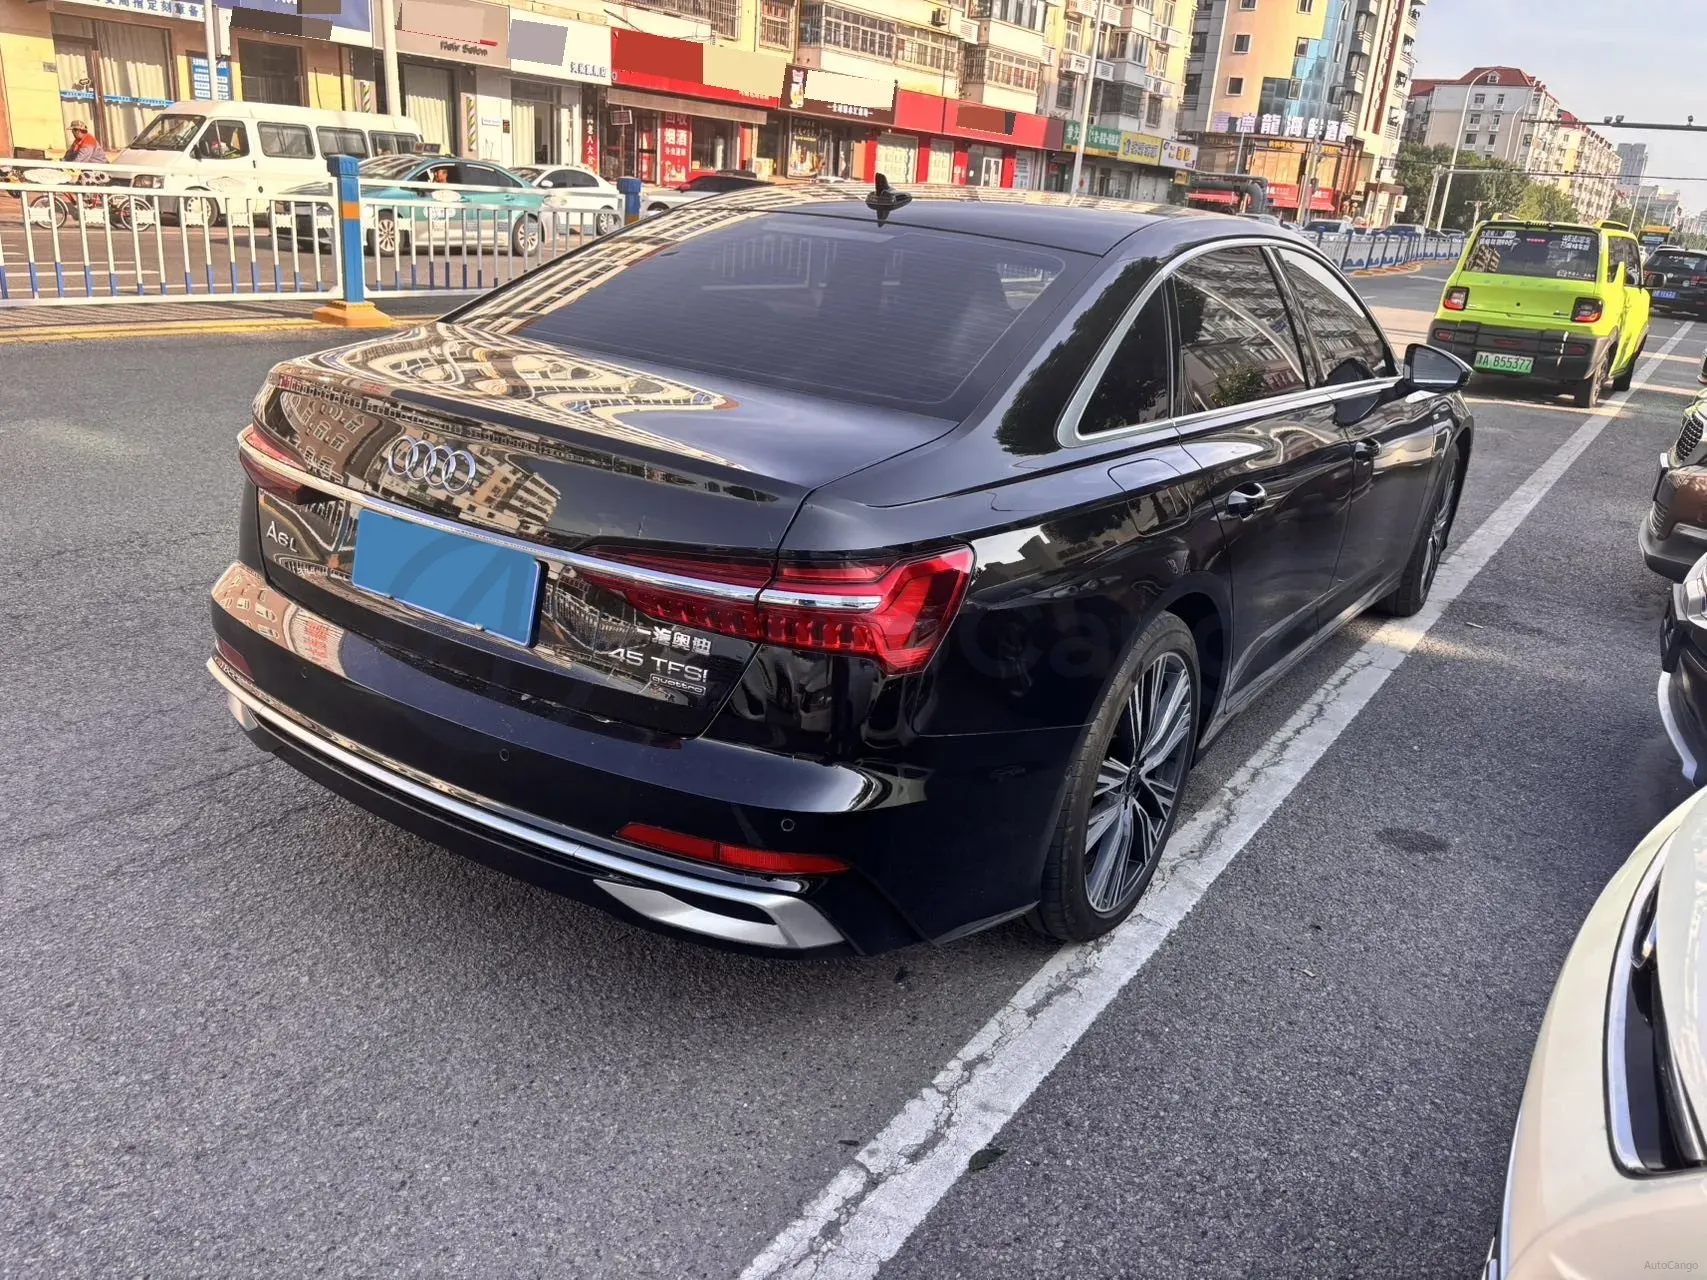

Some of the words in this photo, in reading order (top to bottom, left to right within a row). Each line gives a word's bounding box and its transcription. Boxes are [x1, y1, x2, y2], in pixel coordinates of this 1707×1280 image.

[266, 520, 298, 553] A6L
[608, 647, 644, 667] 45
[650, 656, 709, 683] TFSI
[652, 675, 703, 693] quattro
